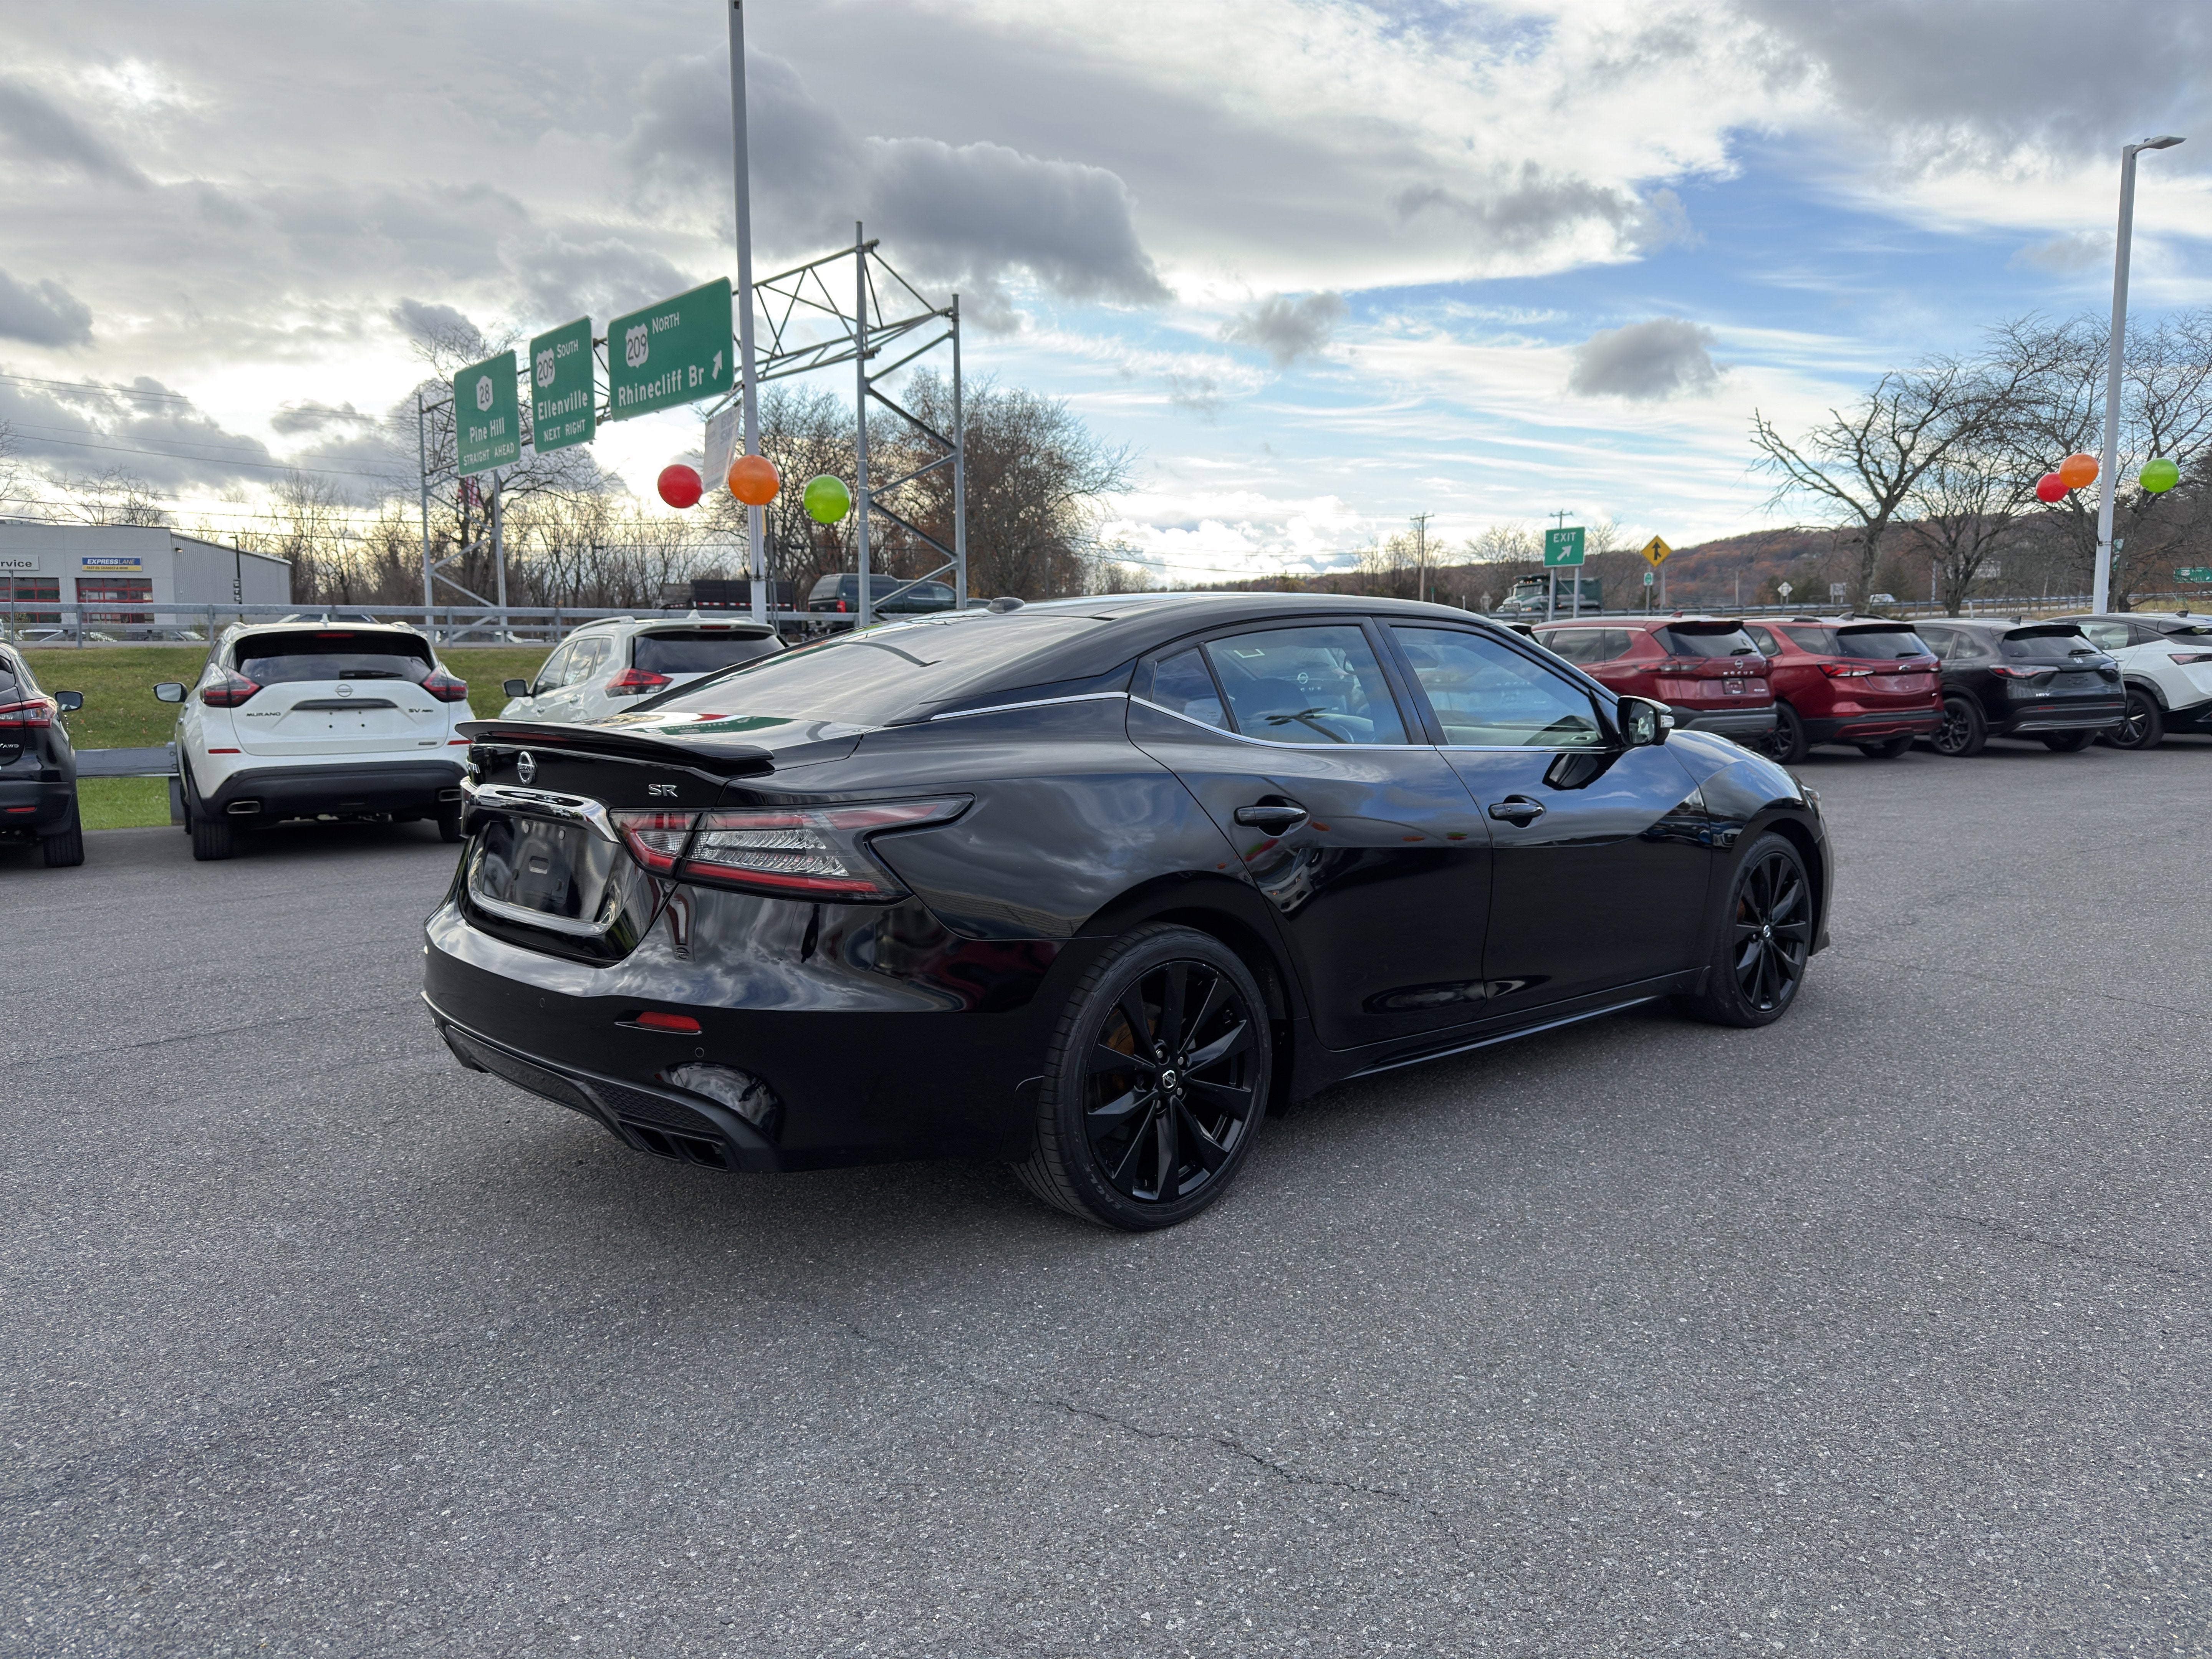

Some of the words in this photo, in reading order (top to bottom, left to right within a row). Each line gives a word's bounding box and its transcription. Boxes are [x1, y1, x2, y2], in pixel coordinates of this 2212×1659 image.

[652, 312, 680, 334] NORTH
[557, 339, 578, 358] SOUTH
[628, 333, 647, 361] 209
[537, 358, 554, 381] 209
[480, 383, 490, 404] 28
[619, 369, 682, 407] Rhinecliff
[689, 365, 704, 387] Br
[538, 389, 588, 421] Ellenville
[470, 426, 487, 444] Pine
[490, 417, 505, 437] Hill
[544, 426, 560, 442] NEXT
[565, 419, 586, 436] RIGHT
[463, 449, 489, 466] STRAIGHT
[494, 442, 515, 458] AHEAD
[1553, 532, 1576, 543] EXIT
[648, 784, 678, 797] SR
[1083, 1163, 1123, 1209] EAGLE
